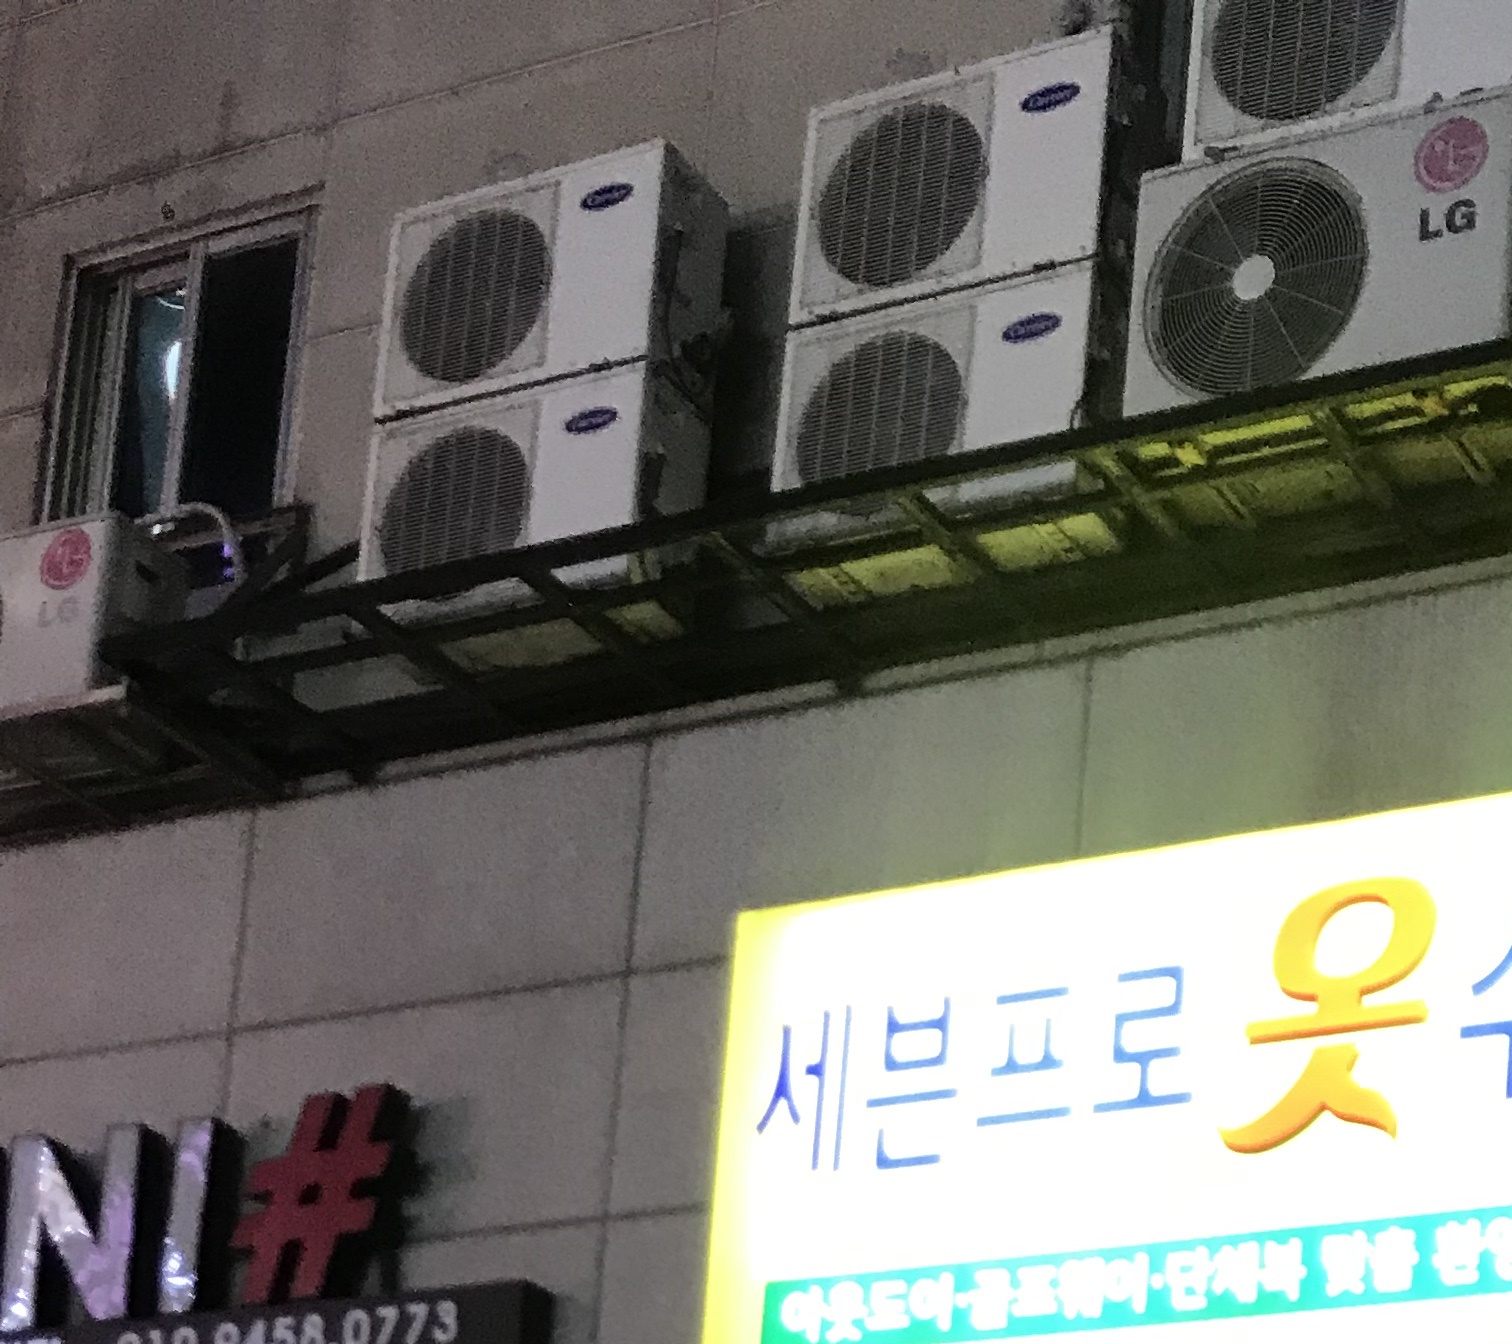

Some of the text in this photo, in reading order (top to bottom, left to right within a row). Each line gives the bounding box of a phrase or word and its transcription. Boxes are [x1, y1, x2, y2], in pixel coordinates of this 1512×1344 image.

[1419, 199, 1478, 241] LG
[755, 965, 1193, 1172] 세븐프로
[1217, 875, 1438, 1155] 옷
